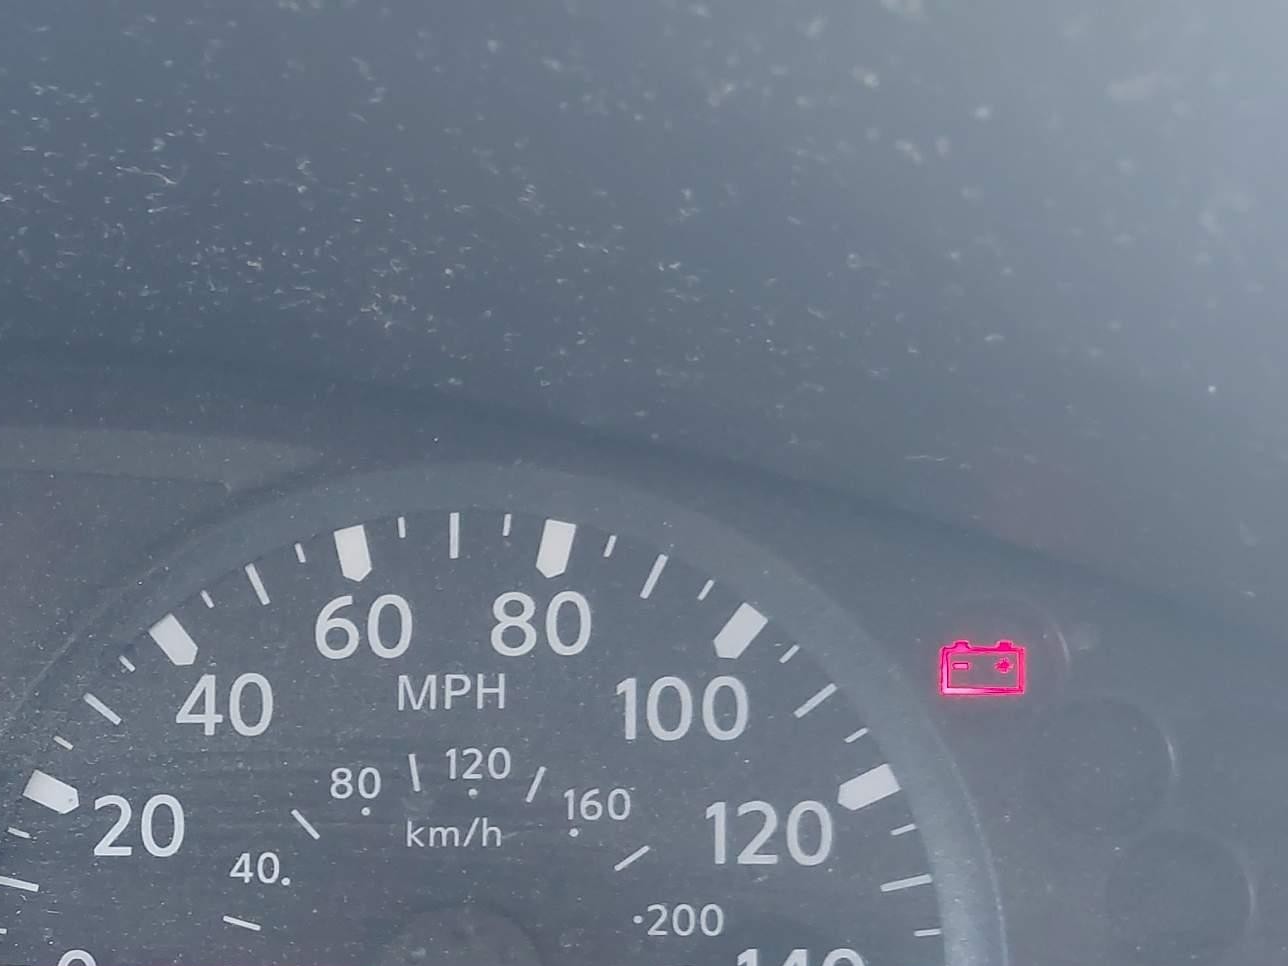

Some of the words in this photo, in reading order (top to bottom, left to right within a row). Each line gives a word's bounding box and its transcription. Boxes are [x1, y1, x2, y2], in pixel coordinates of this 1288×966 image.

[313, 594, 414, 660] 60
[489, 590, 593, 657] 80
[175, 673, 274, 736] 40
[396, 674, 508, 711] MPH
[614, 676, 749, 741] 100
[330, 767, 382, 800] 80
[444, 748, 512, 780] 120
[93, 794, 186, 857] 20
[563, 789, 632, 821] 160
[405, 818, 503, 849] km/h
[704, 801, 833, 866] 120
[646, 904, 725, 936] 200
